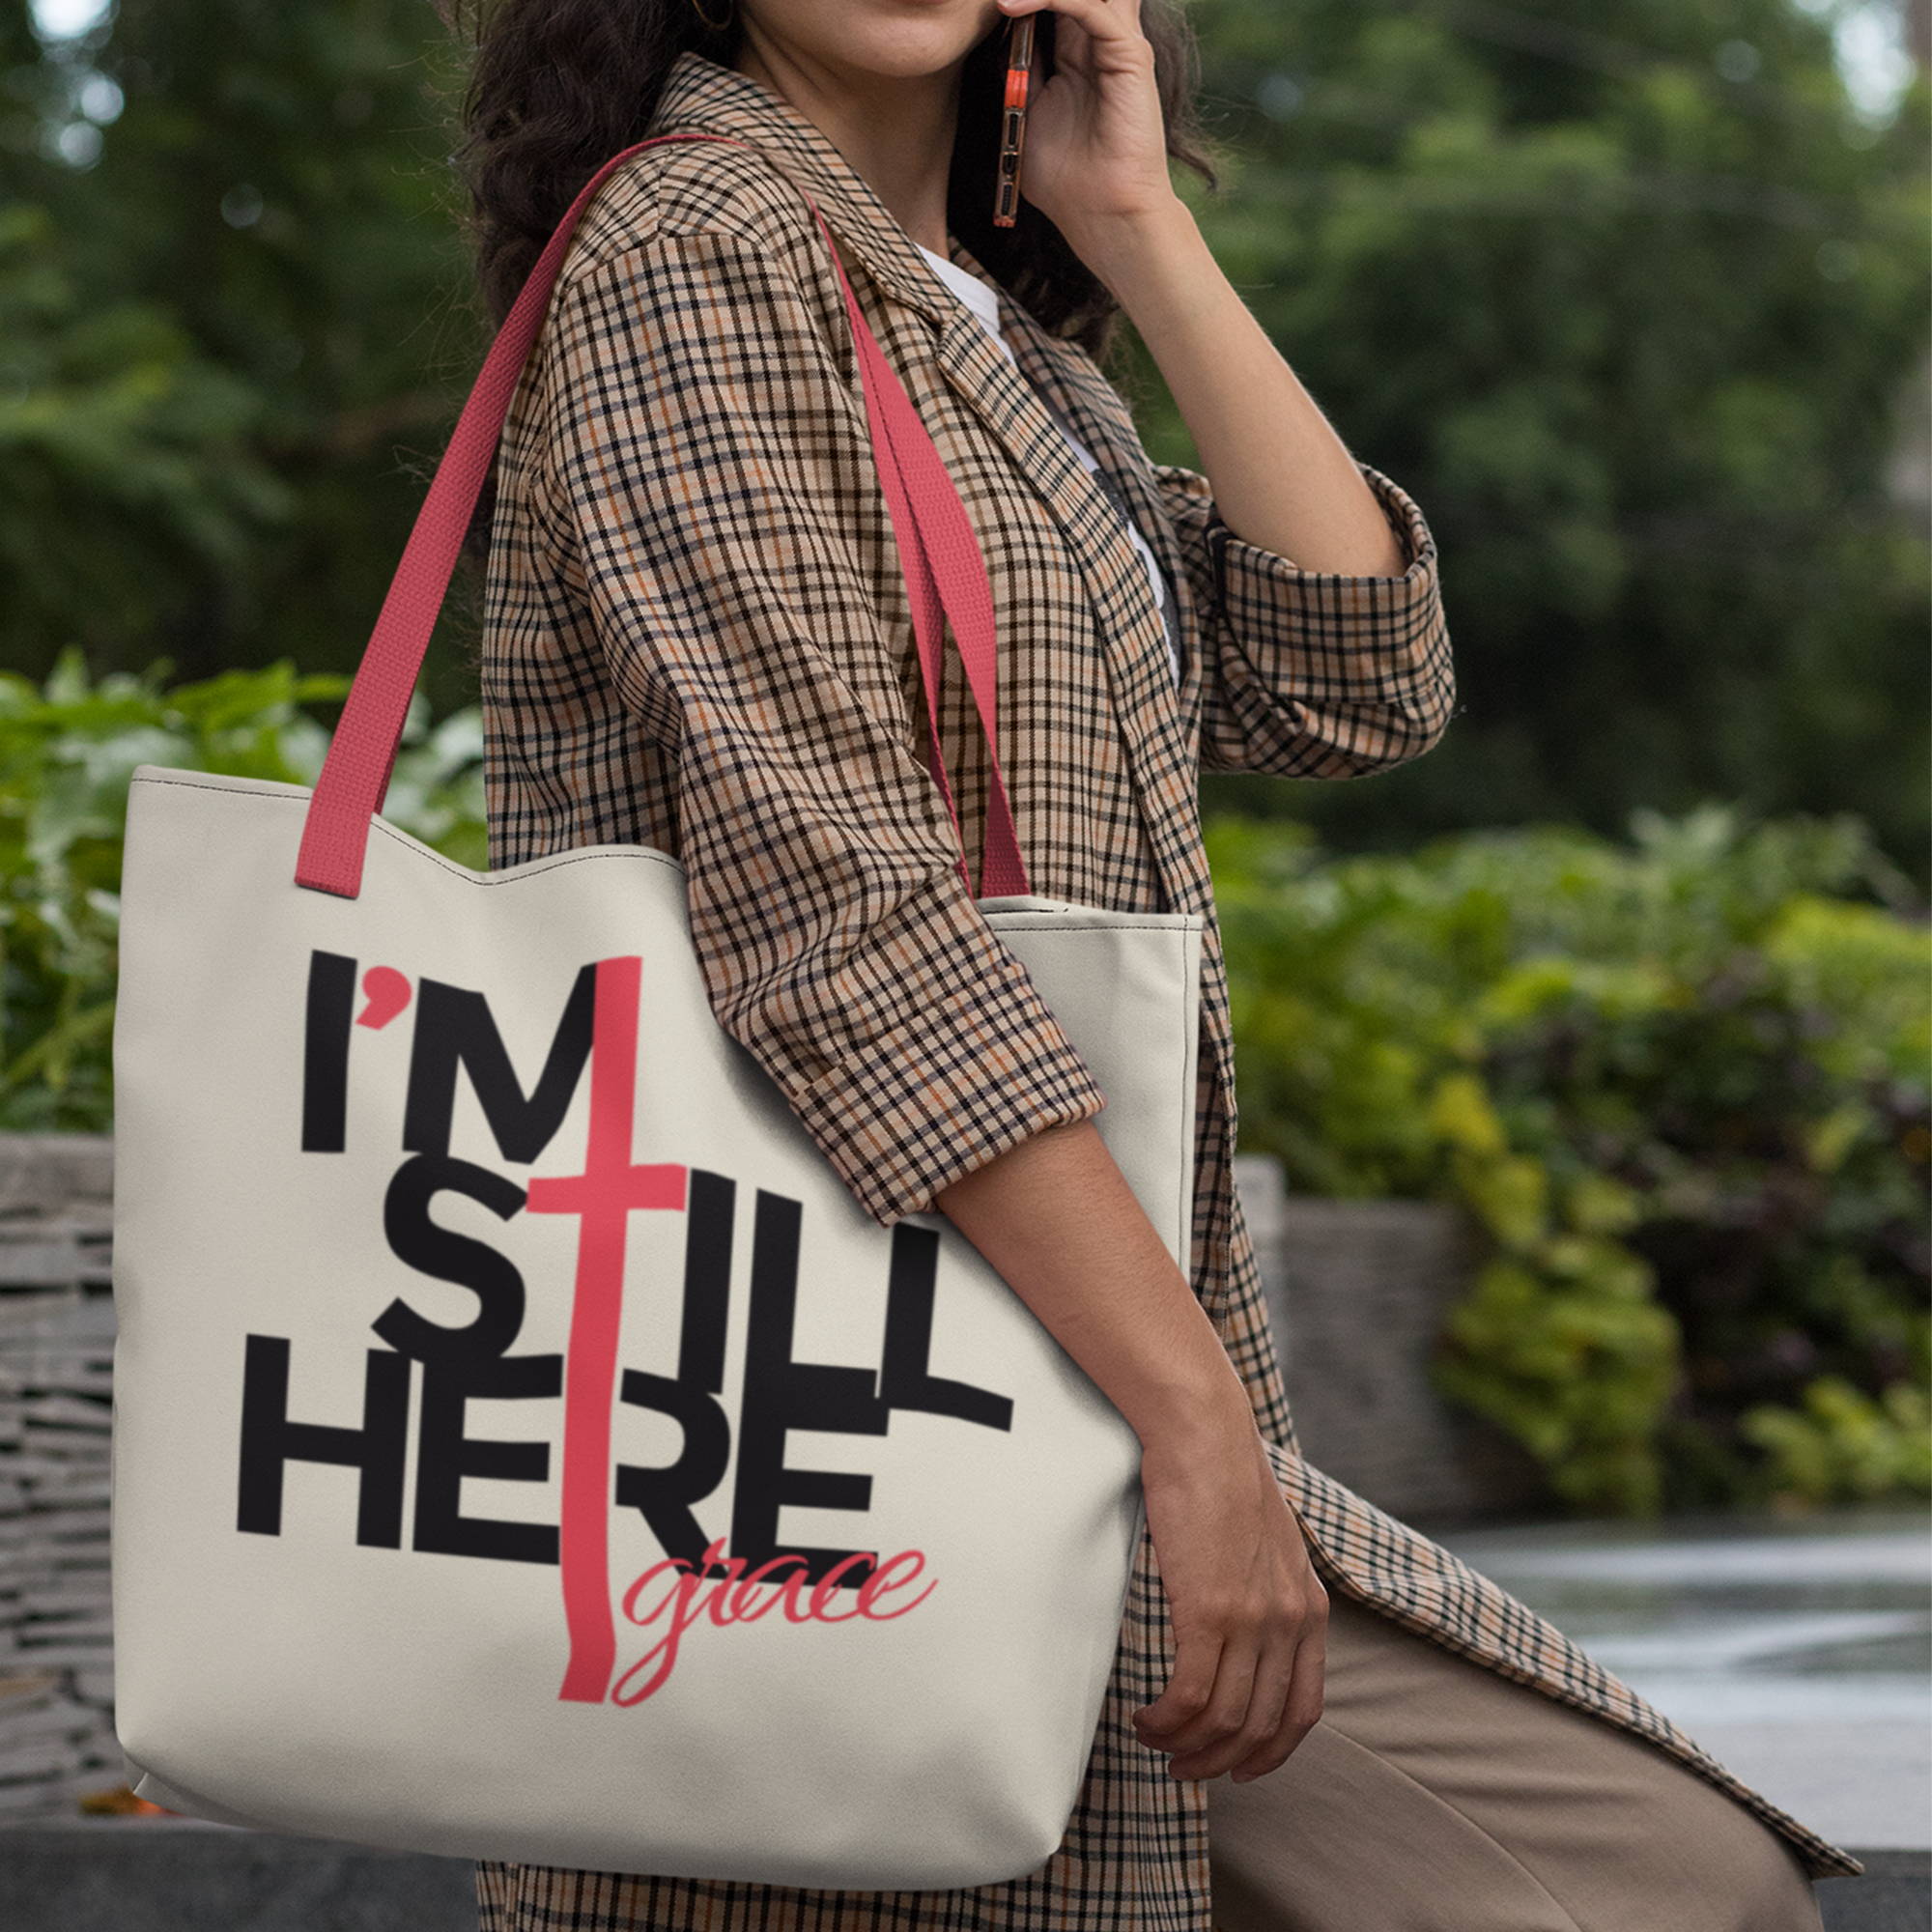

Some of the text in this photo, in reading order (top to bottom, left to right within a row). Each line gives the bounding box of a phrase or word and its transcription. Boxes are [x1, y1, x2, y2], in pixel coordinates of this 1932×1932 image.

[301, 949, 643, 1165] I'M
[370, 1151, 1014, 1434] STILL
[237, 1333, 879, 1591] HERE
[611, 1536, 939, 1708] grace
